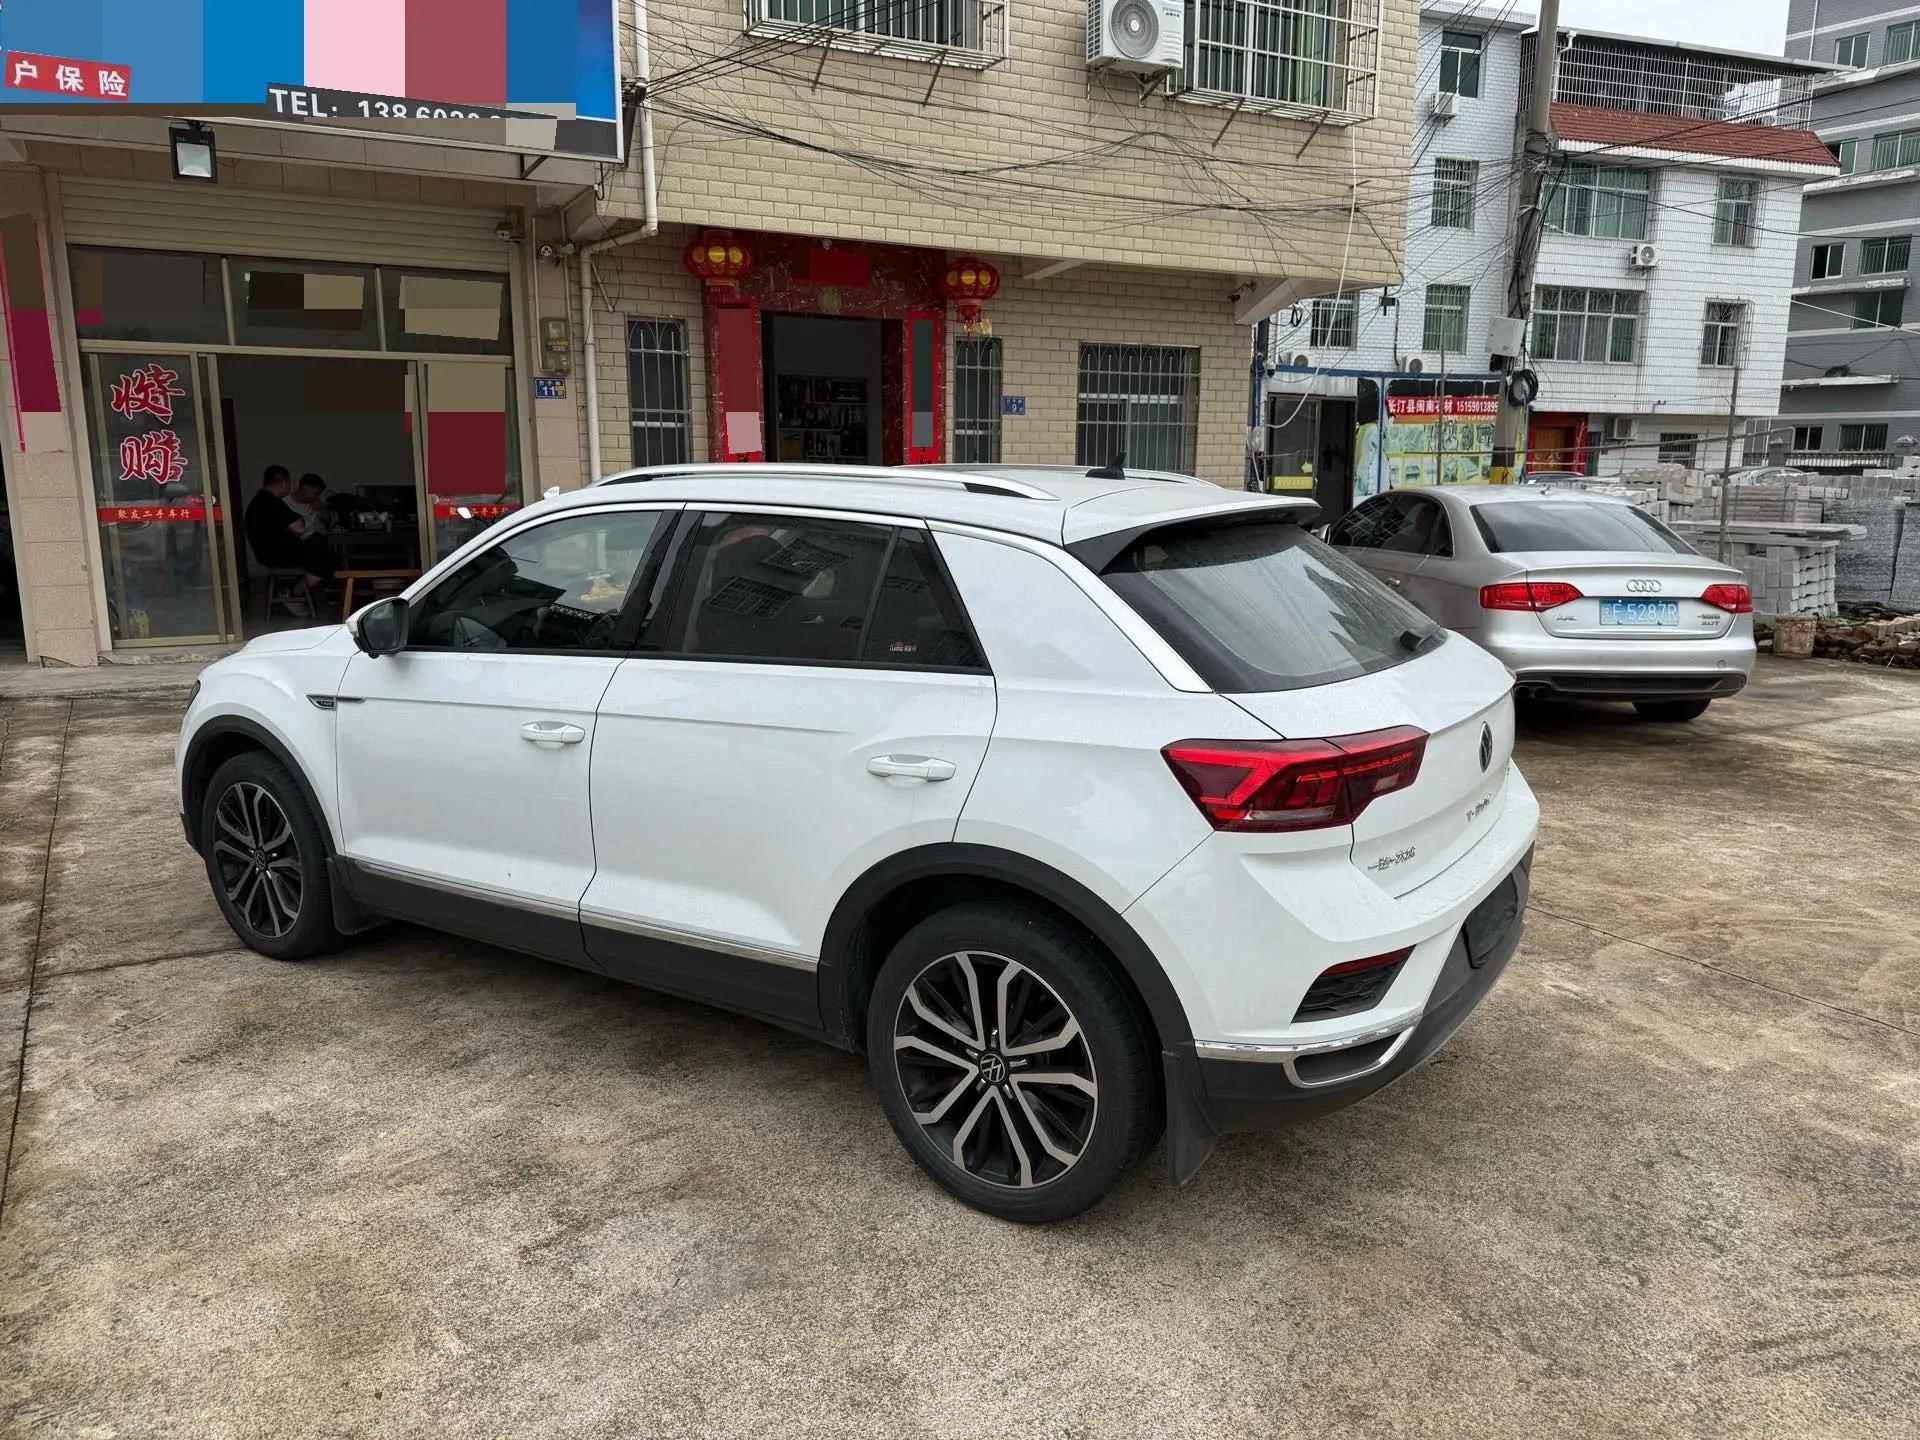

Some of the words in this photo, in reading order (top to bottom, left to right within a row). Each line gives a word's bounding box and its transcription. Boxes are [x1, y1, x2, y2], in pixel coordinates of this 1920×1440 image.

[13, 60, 127, 97] 户保险
[448, 506, 508, 517] 聚二手车
